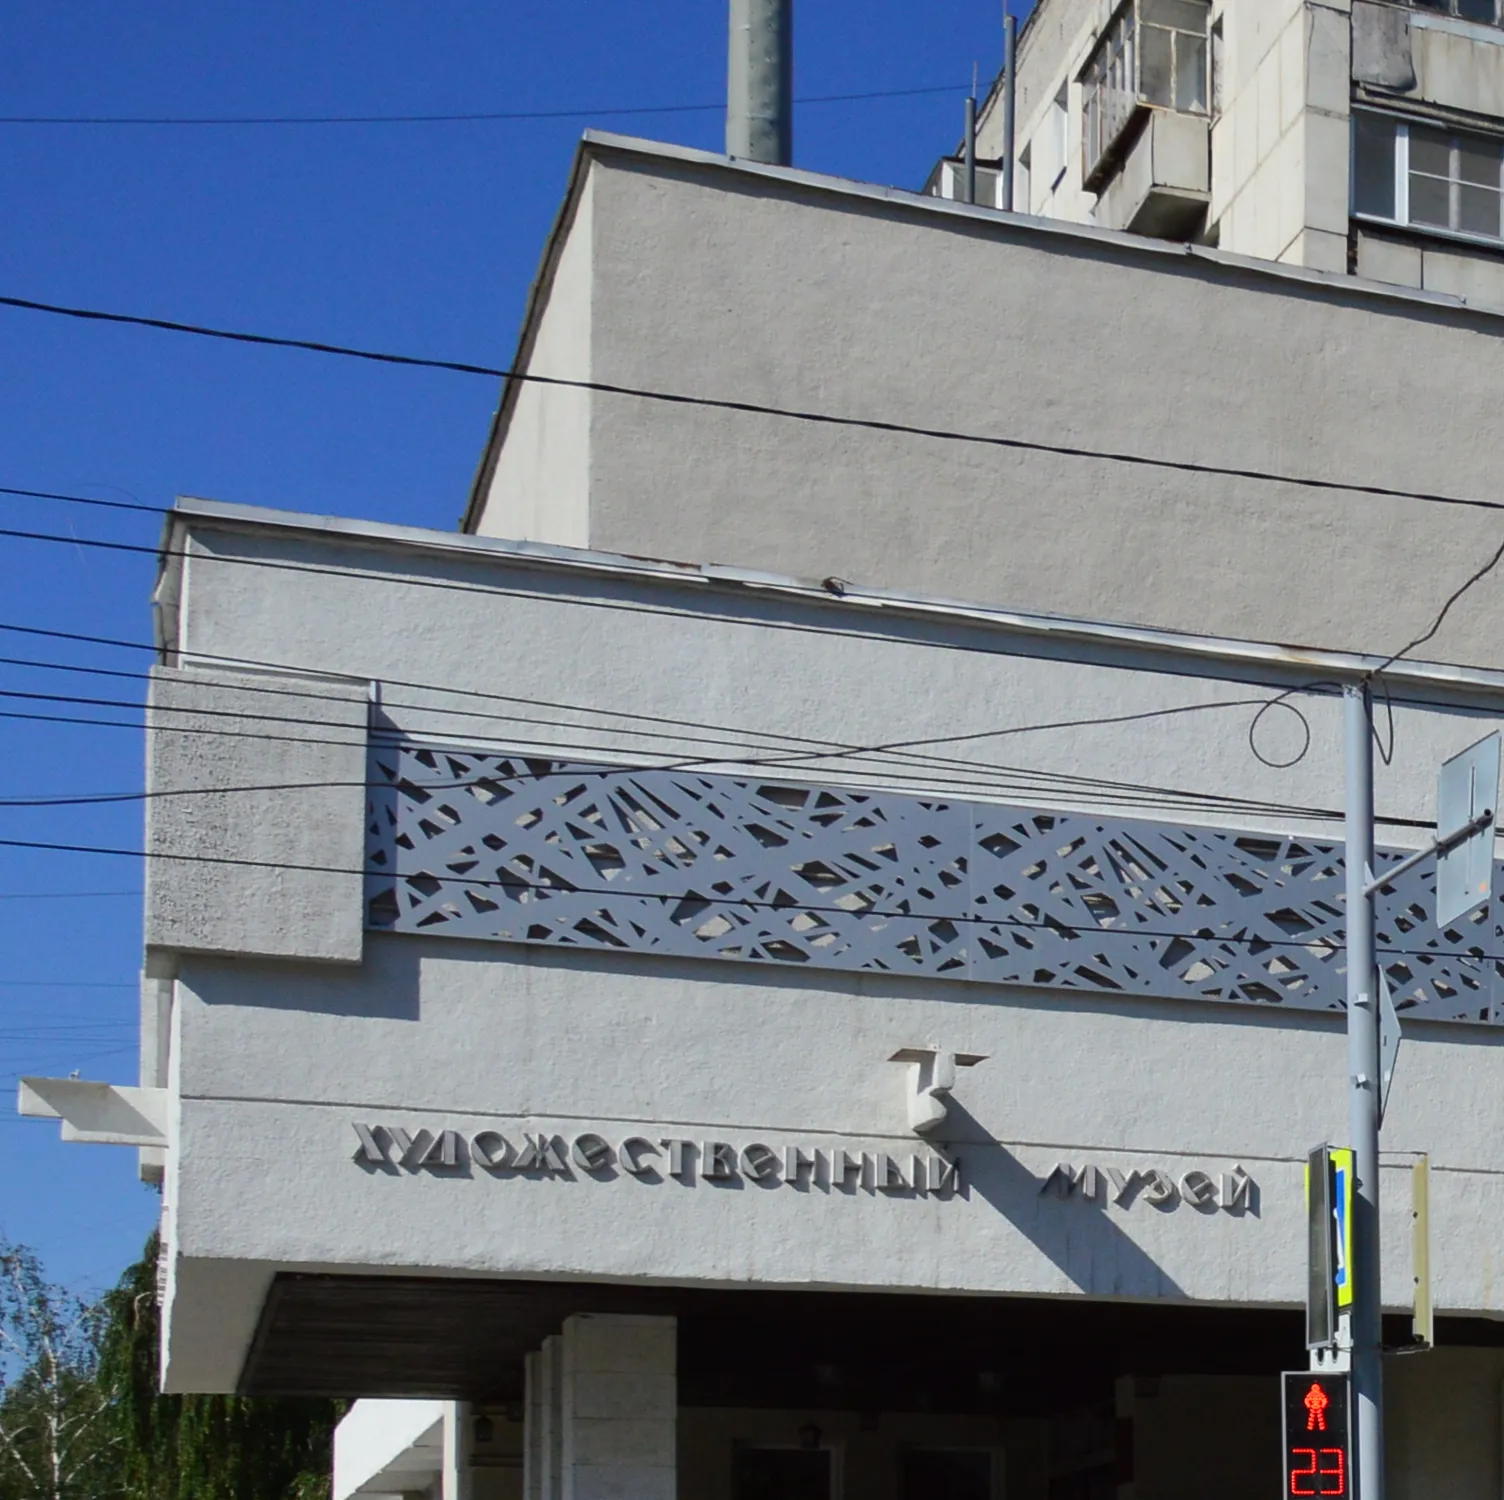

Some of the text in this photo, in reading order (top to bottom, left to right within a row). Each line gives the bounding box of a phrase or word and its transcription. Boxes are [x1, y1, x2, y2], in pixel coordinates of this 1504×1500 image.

[351, 1121, 1257, 1213] ХУДОЖЕСТВЕННЫЙ МУЗЕЙ
[1290, 1448, 1344, 1496] 23
